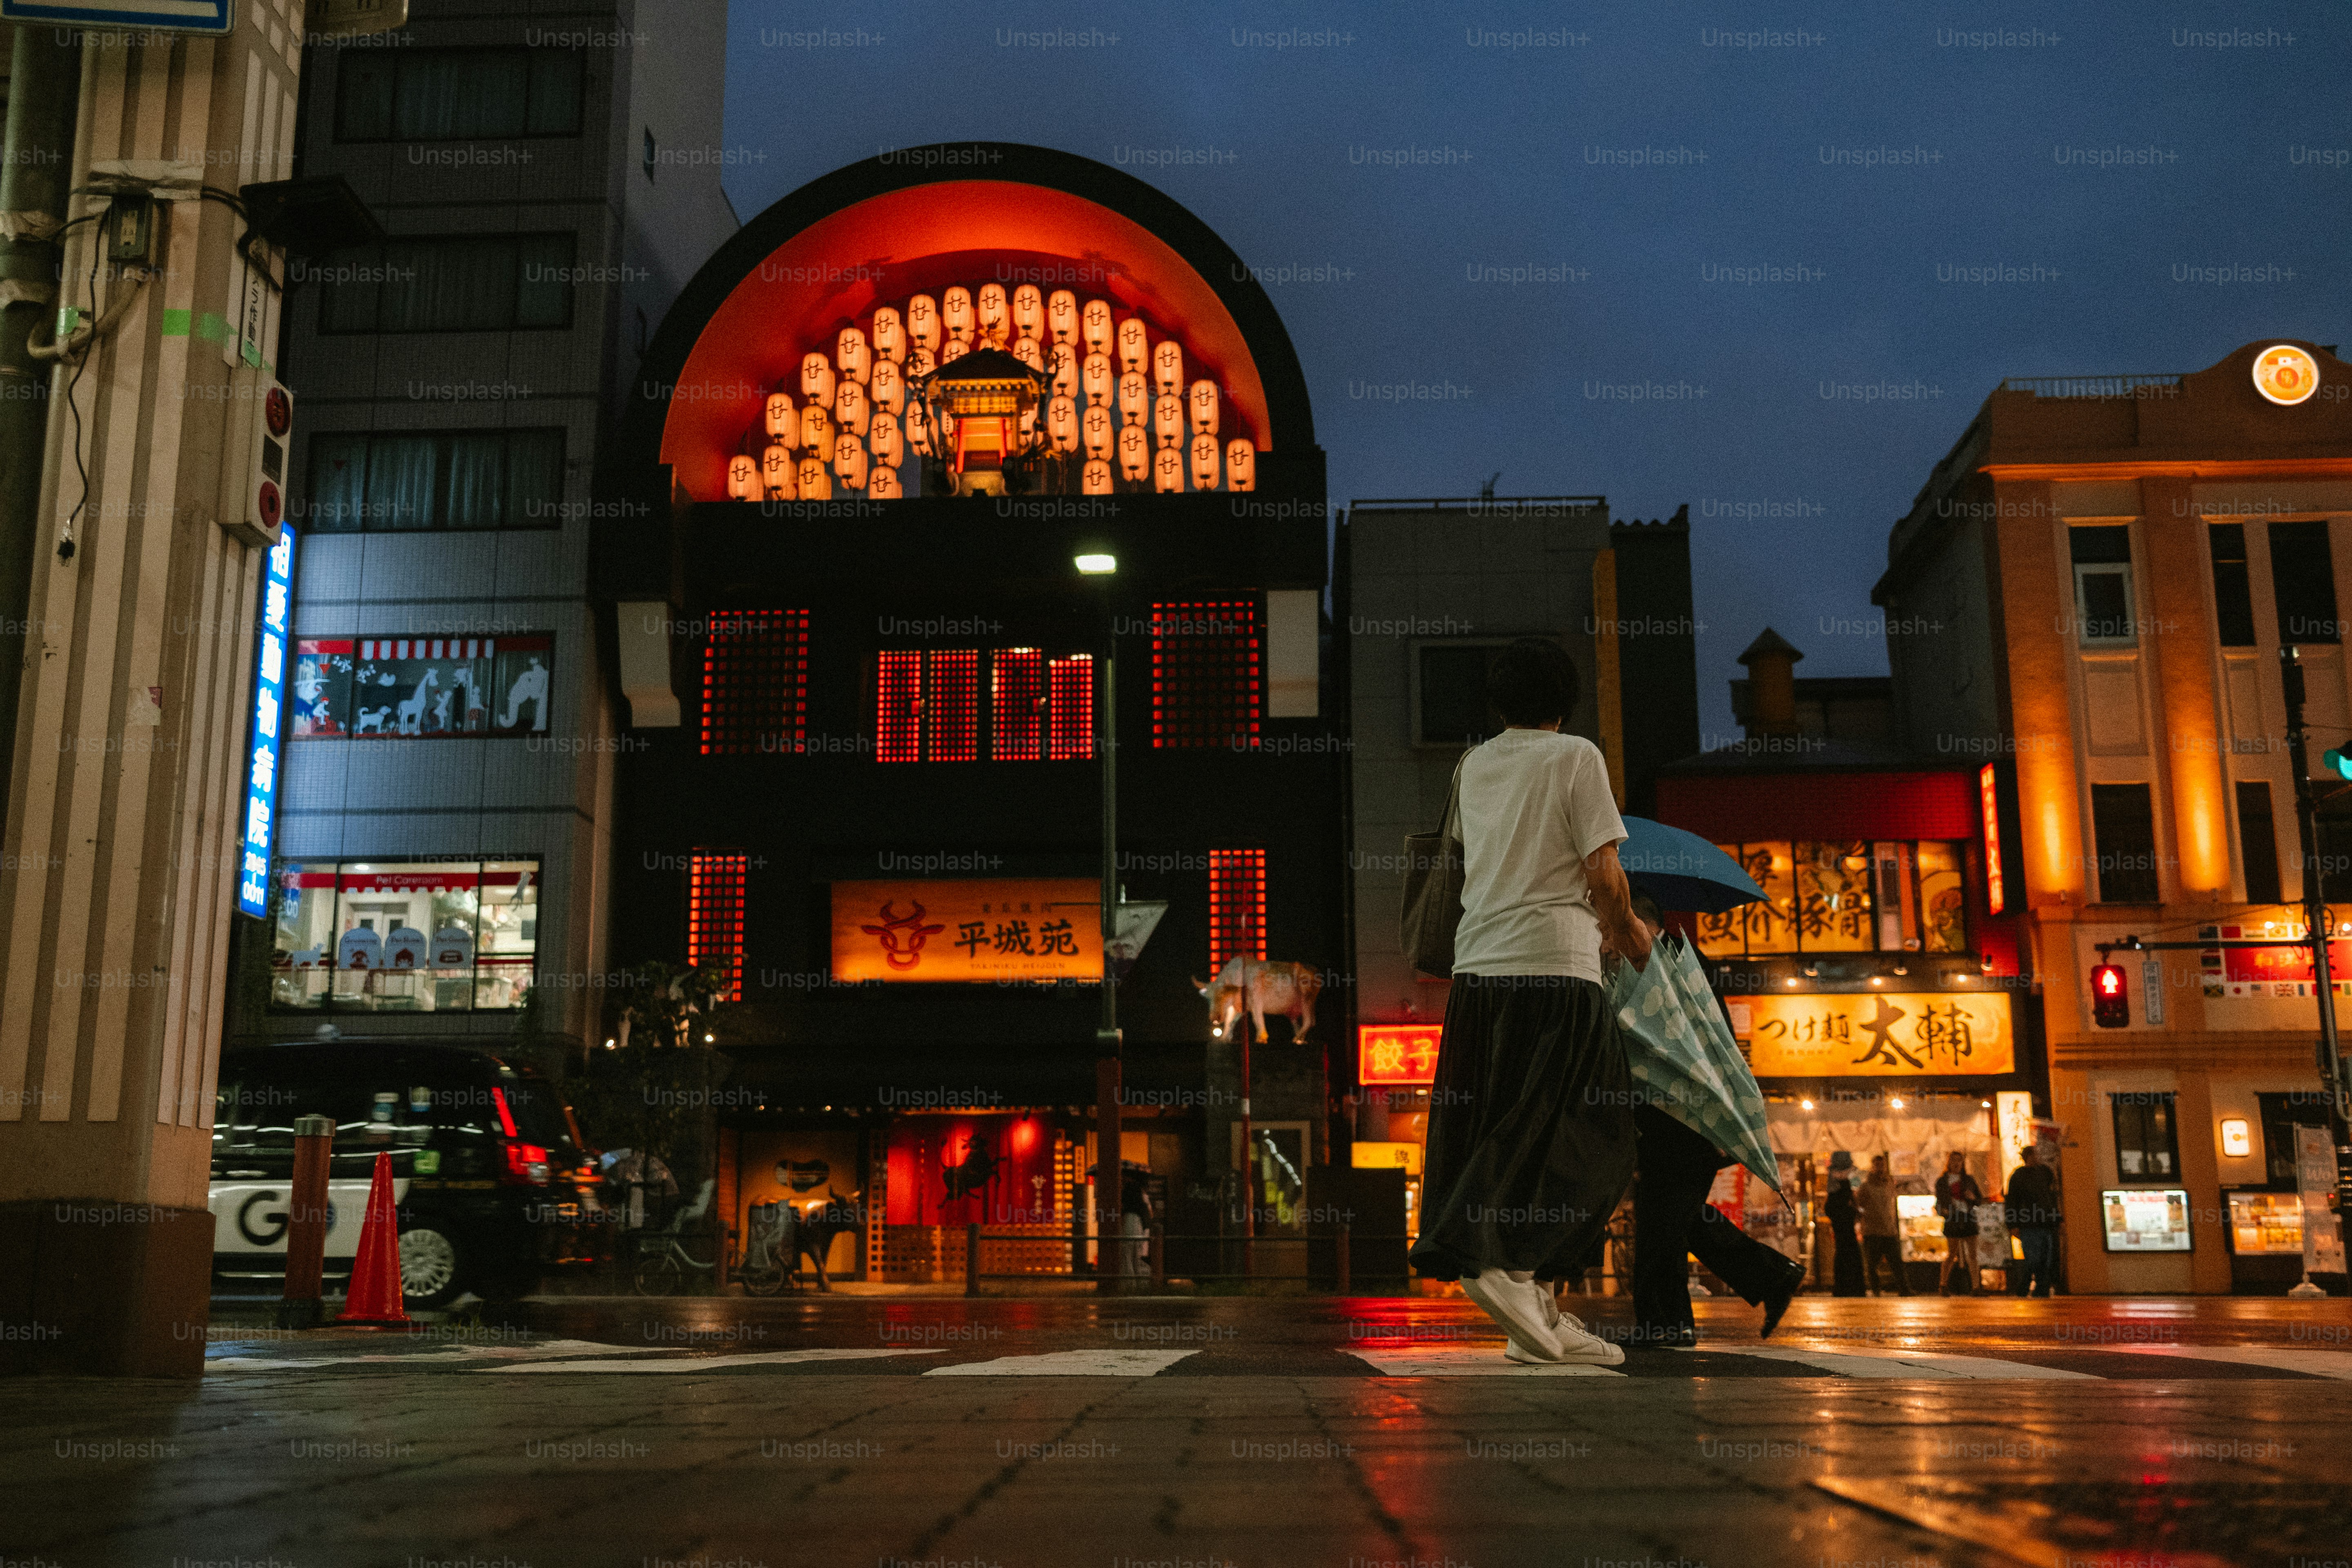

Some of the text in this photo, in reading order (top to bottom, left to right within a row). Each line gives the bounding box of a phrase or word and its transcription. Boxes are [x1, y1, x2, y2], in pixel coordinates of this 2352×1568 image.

[376, 875, 443, 884] Pet Careroom
[954, 918, 1080, 958] 平城苑
[1852, 997, 1973, 1069] 太輔
[1369, 1038, 1439, 1072] 餃子
